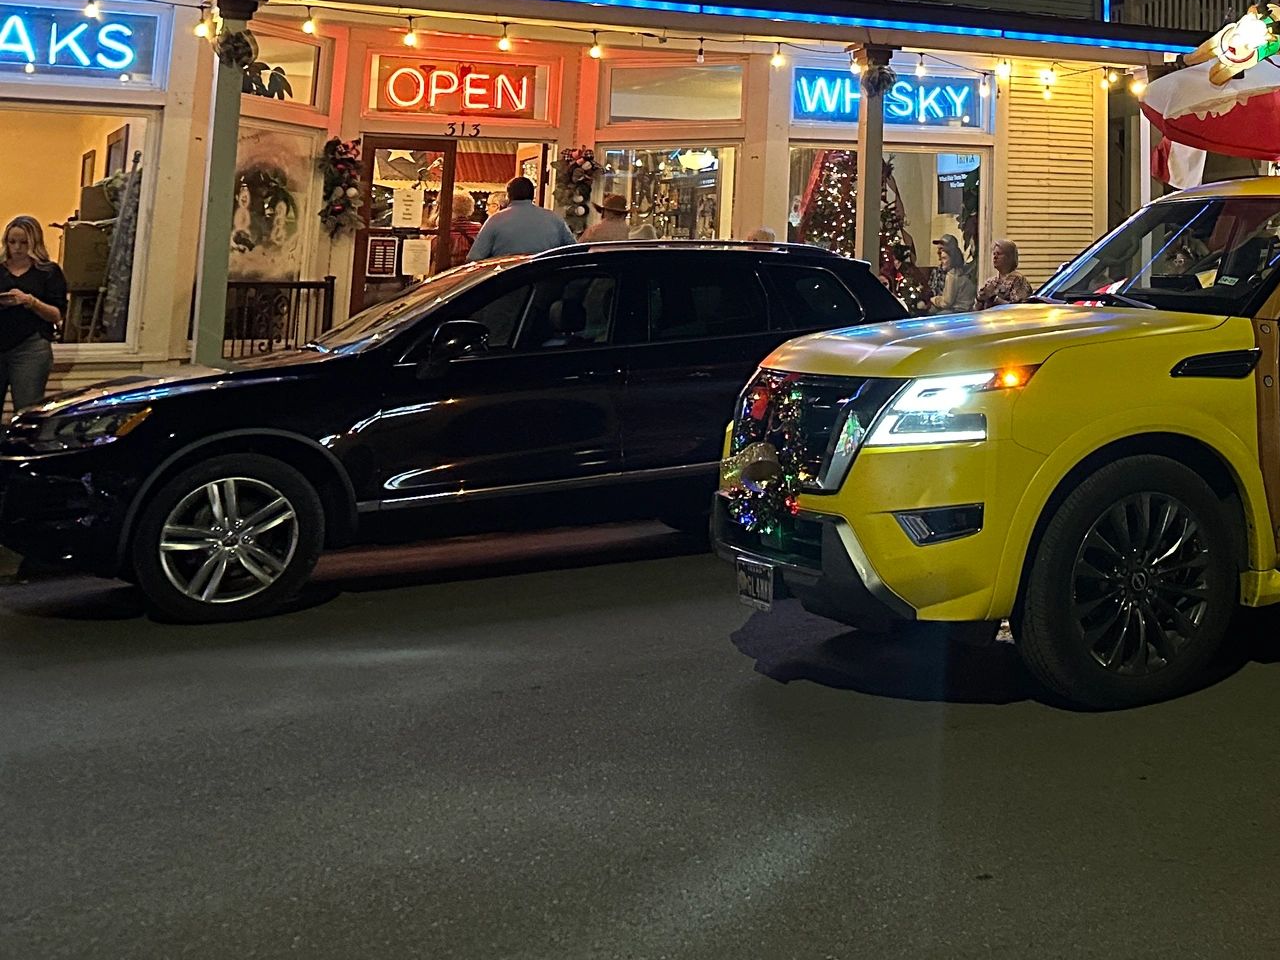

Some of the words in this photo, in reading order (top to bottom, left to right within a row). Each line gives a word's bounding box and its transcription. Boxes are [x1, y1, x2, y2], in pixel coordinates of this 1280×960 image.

[0, 14, 135, 70] AKS
[386, 67, 528, 111] OPEN
[798, 76, 969, 119] WHSKY
[444, 121, 481, 138] 313
